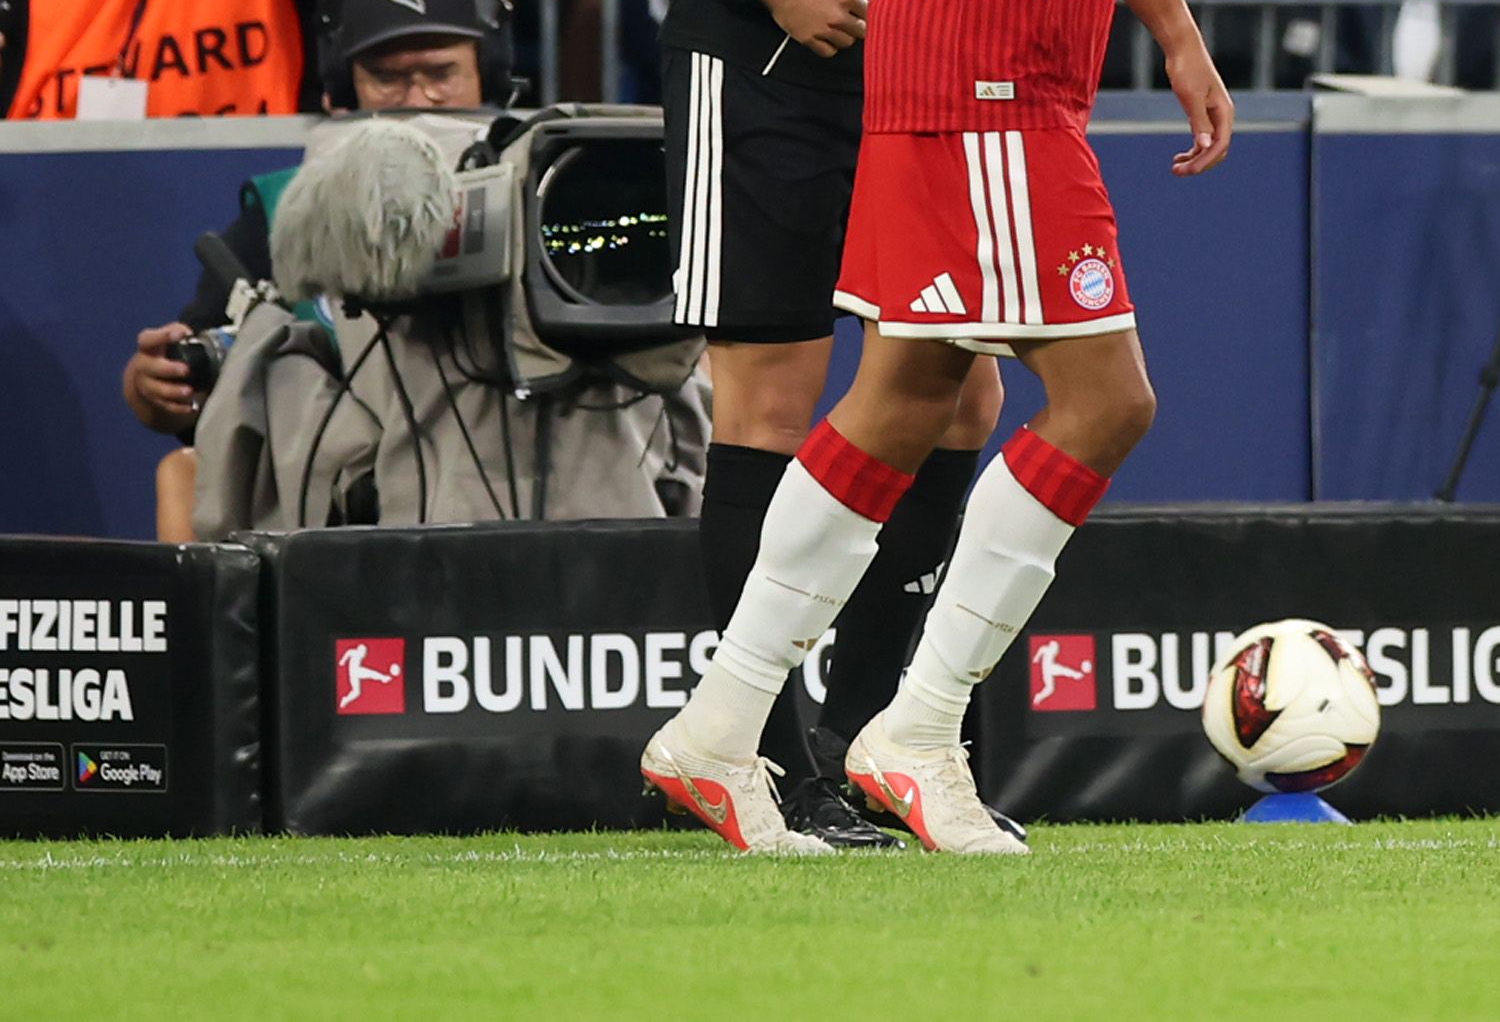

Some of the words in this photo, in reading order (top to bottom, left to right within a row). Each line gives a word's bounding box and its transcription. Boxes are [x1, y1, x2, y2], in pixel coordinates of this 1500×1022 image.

[28, 21, 269, 116] TARD
[2, 762, 27, 783] App
[28, 762, 60, 780] Store
[100, 762, 139, 786] Google
[139, 764, 162, 786] Play
